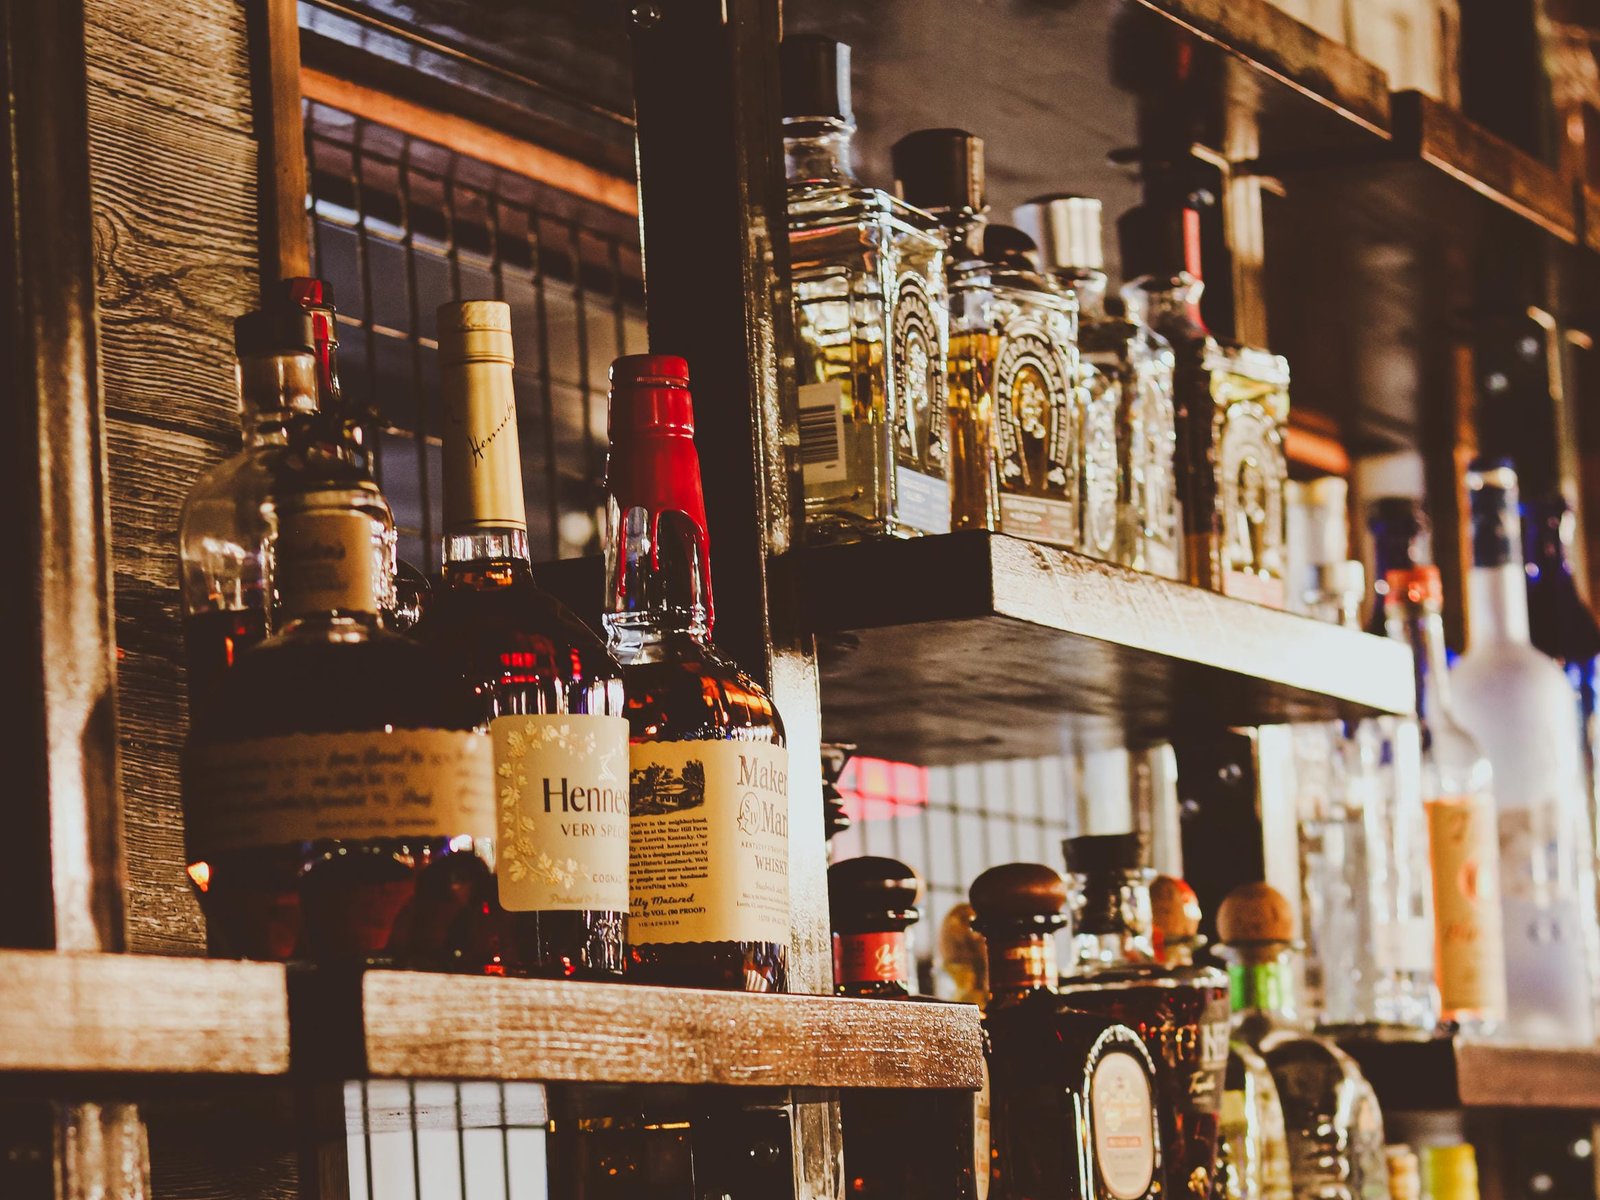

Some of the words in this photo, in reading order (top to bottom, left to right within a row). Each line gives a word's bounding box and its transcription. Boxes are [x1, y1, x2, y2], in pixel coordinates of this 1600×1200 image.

[561, 823, 596, 837] VERY
[658, 826, 667, 834] the
[652, 893, 695, 906] Matured
